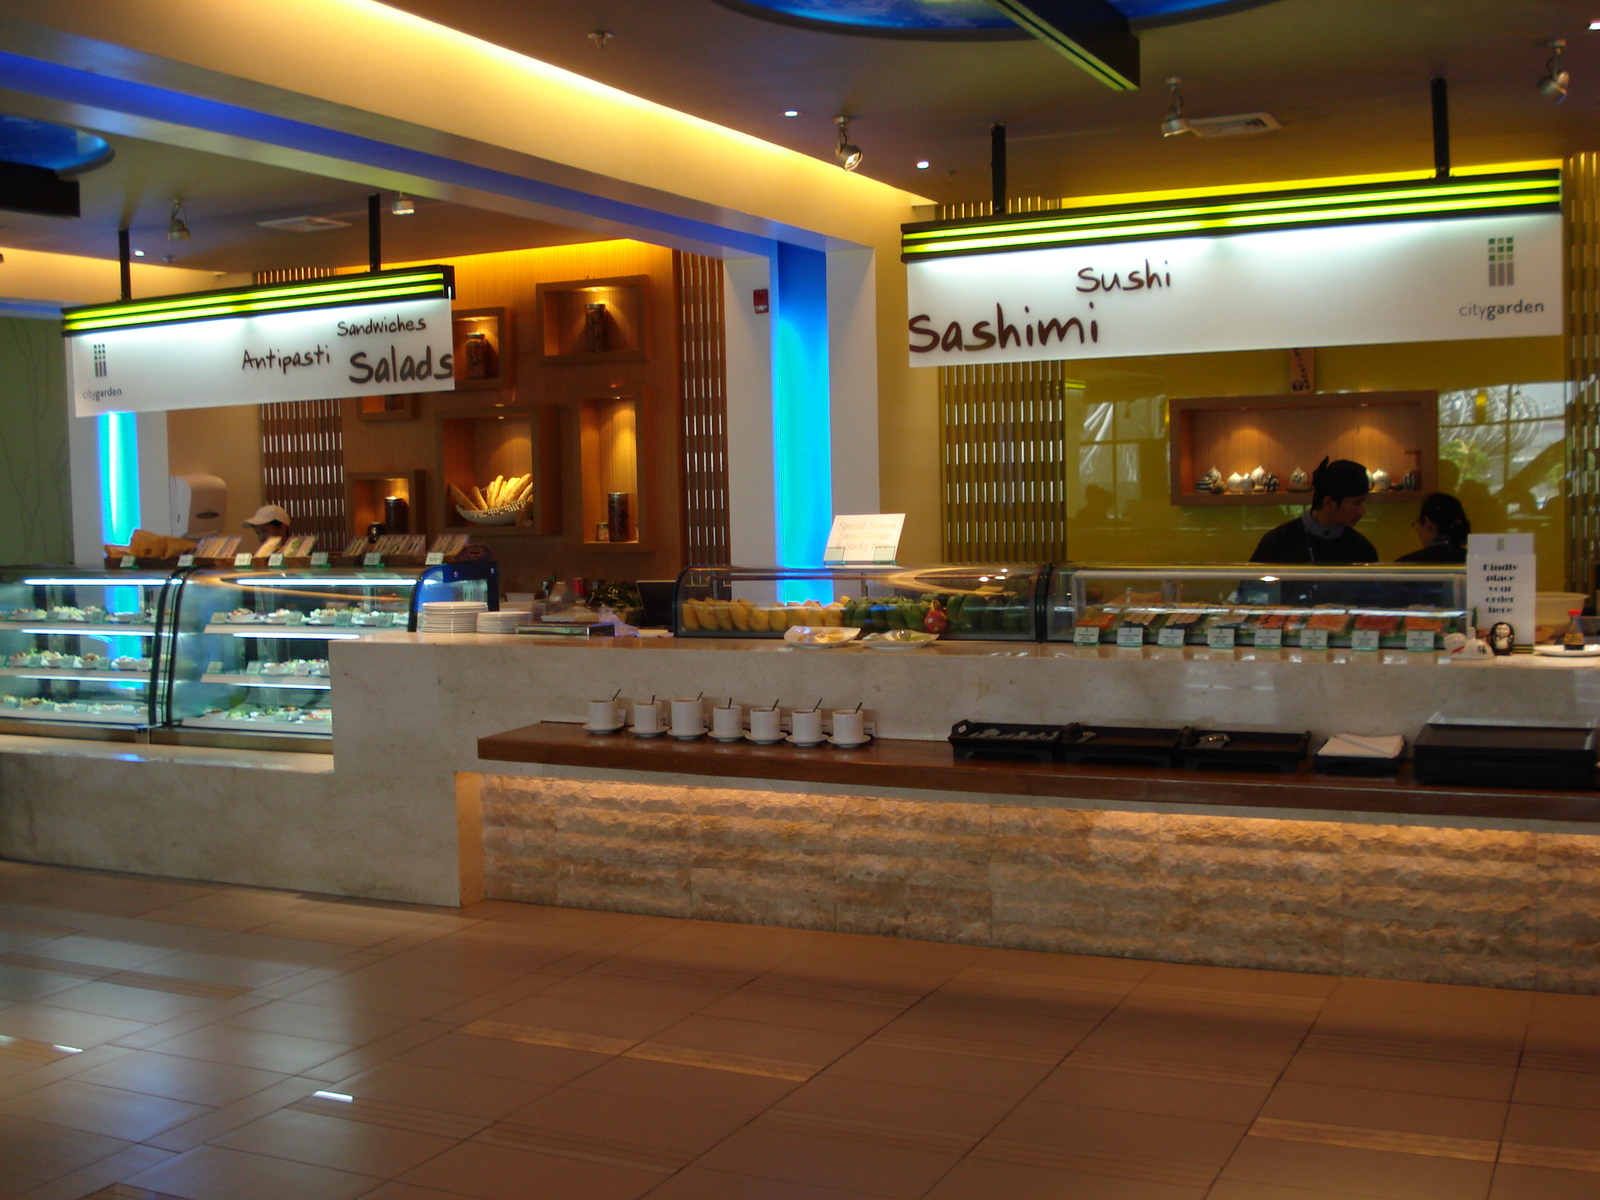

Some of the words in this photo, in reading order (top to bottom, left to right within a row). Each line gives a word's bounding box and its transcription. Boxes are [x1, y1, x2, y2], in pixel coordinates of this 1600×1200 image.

[1076, 258, 1171, 293] Sushi
[1459, 299, 1544, 320] citygarden
[337, 313, 427, 337] Sandwiches
[908, 301, 1098, 353] Sashimi
[241, 343, 331, 374] Antipasti
[349, 345, 453, 384] Salads
[1486, 574, 1515, 582] place
[1485, 595, 1515, 603] order
